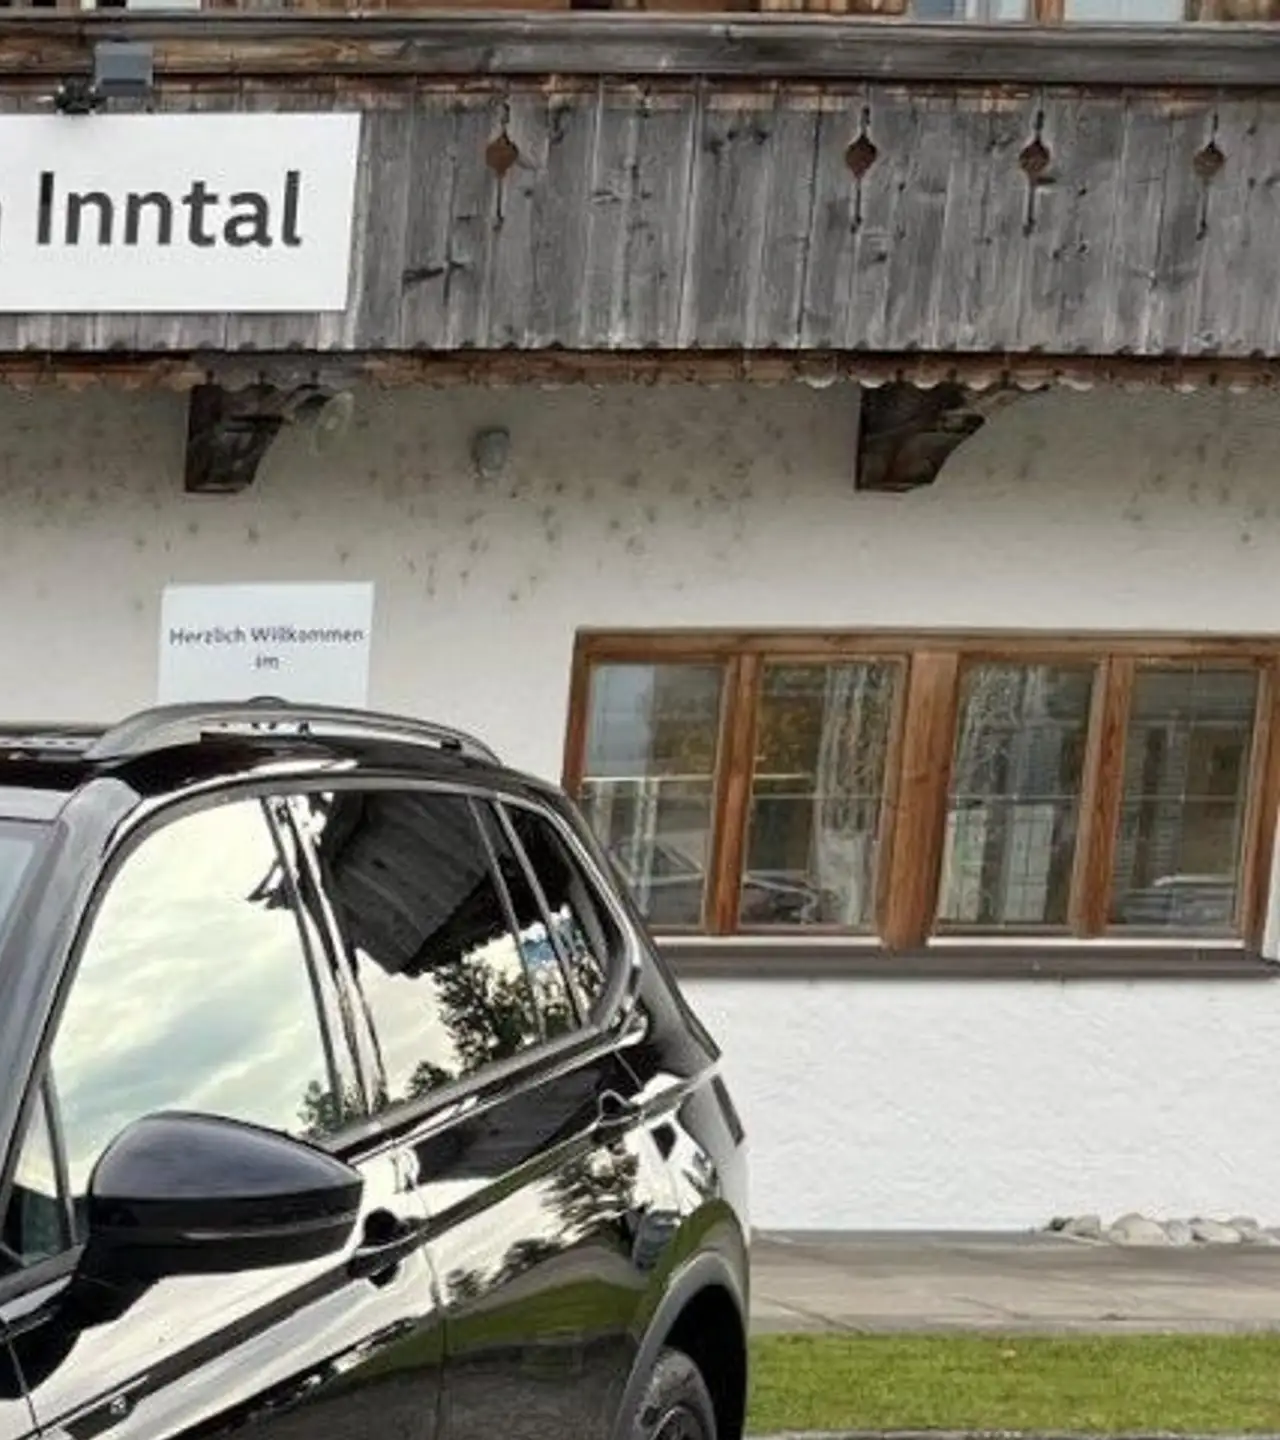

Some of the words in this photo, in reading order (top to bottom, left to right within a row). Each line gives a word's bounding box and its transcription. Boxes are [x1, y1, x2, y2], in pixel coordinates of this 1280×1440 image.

[37, 169, 303, 248] Inntal
[169, 626, 246, 647] Herzlich
[250, 625, 365, 645] Willkommen
[254, 653, 280, 670] im
